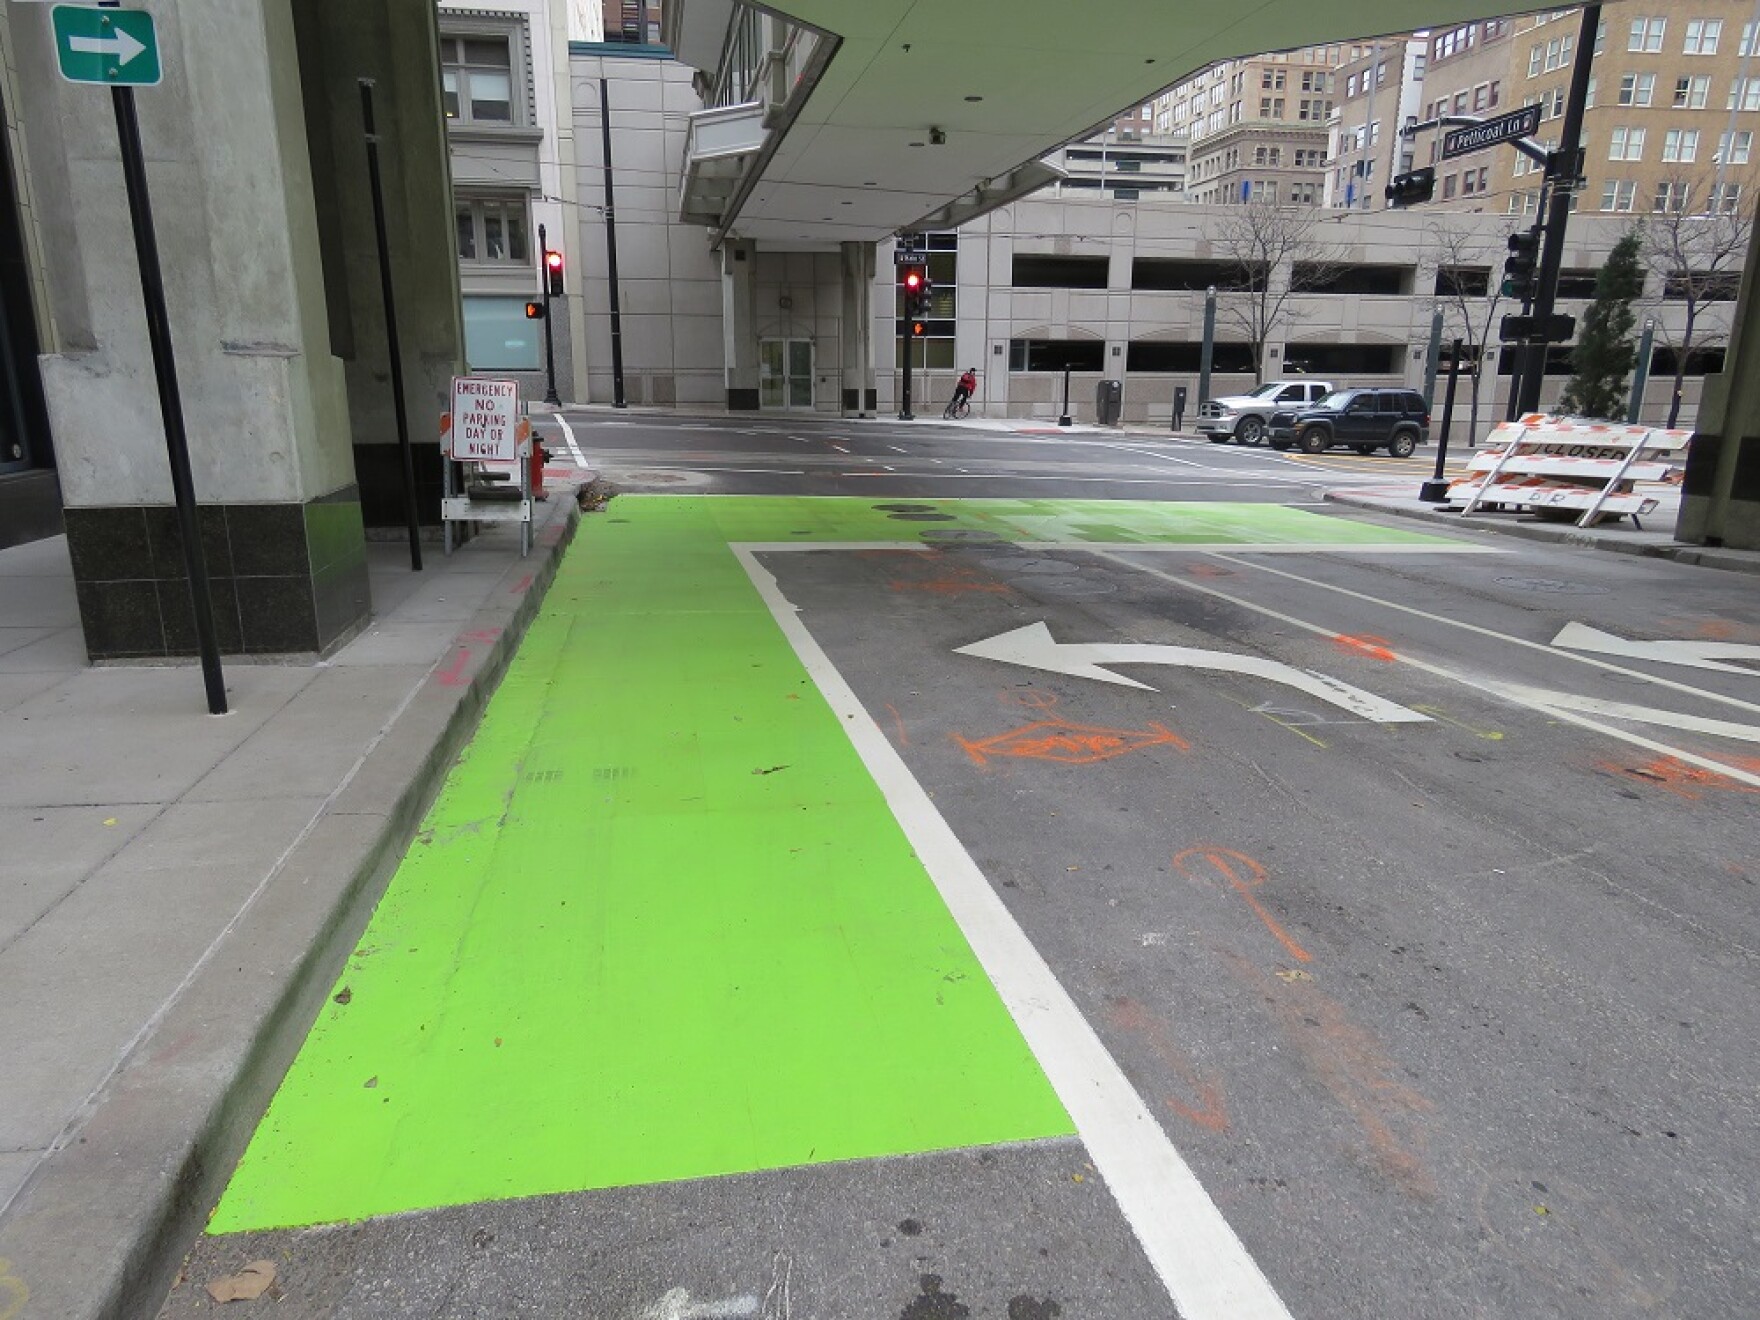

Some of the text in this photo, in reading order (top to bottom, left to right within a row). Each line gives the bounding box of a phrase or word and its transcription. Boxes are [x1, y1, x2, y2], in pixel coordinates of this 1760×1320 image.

[1508, 119, 1520, 135] Ln
[457, 382, 513, 397] EMERGENCY
[474, 399, 496, 411] NO
[462, 412, 506, 427] PARKING
[466, 427, 504, 441] DAY OR
[469, 443, 501, 455] NIGHT
[1544, 443, 1626, 460] CLOSED
